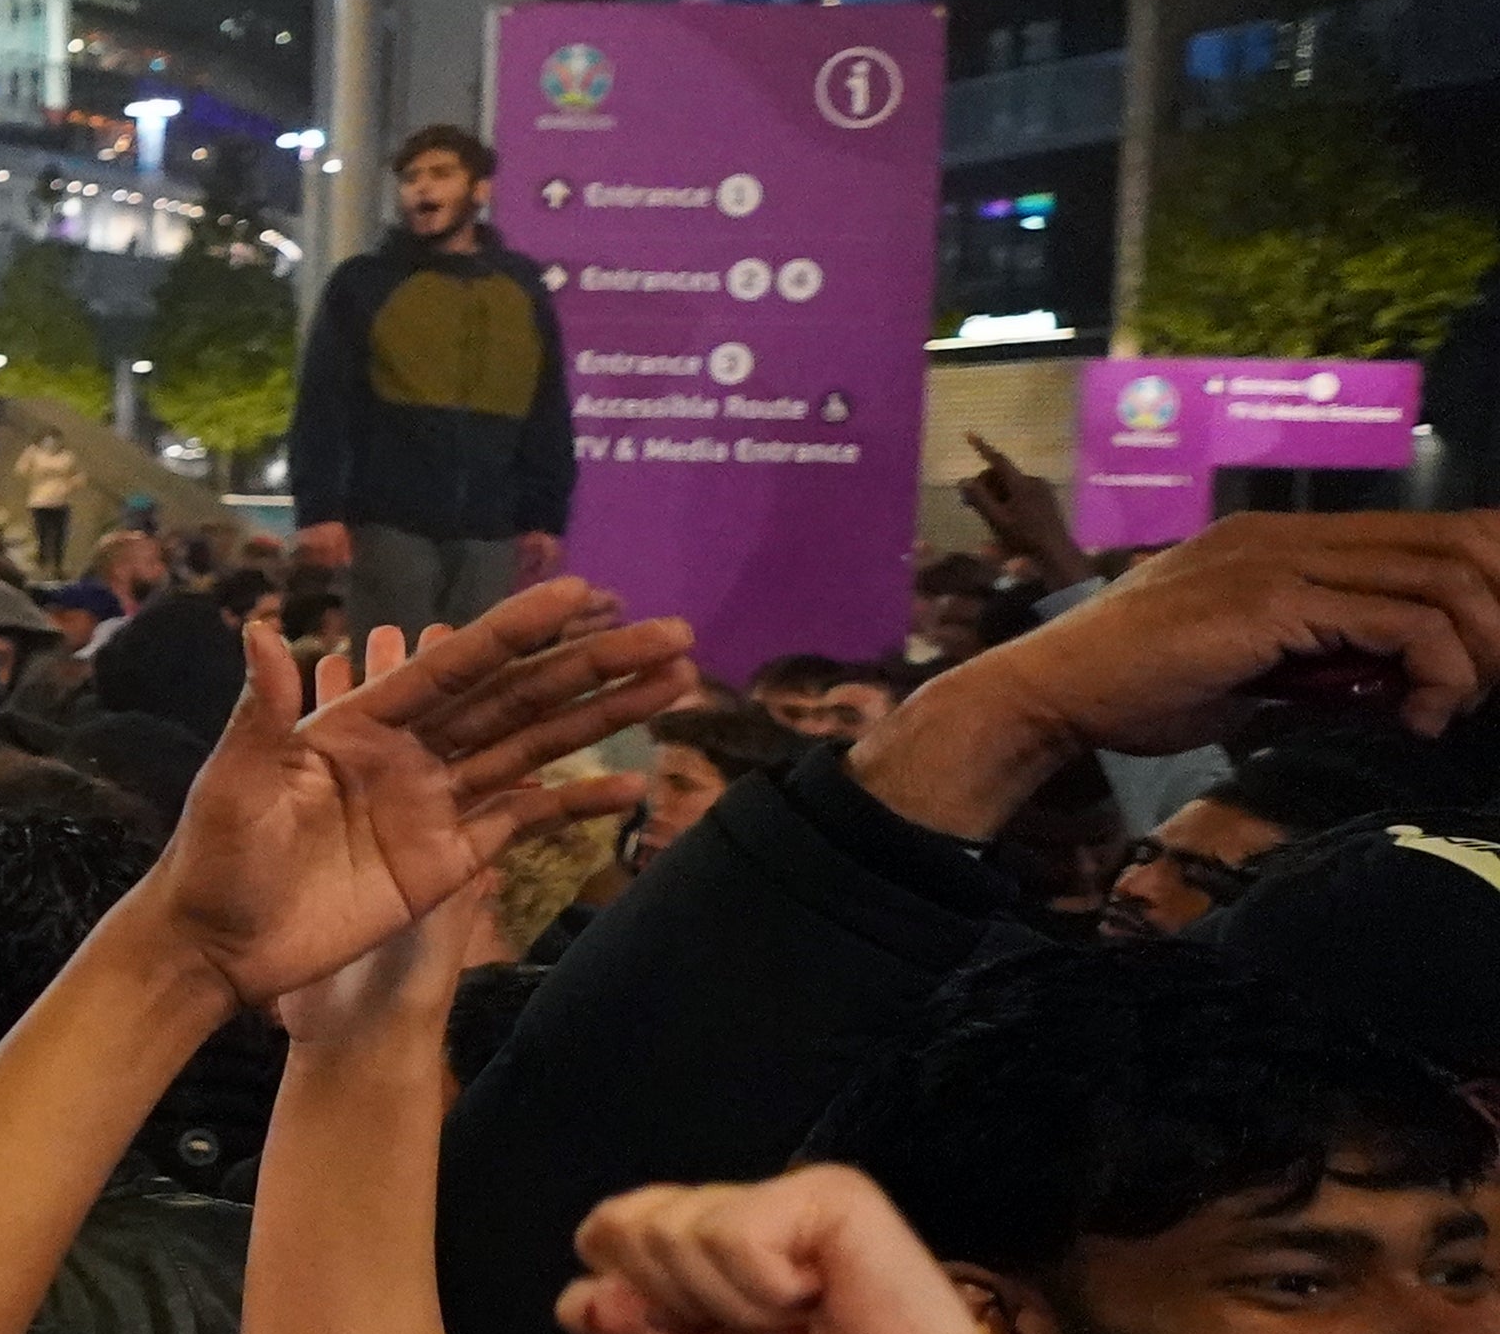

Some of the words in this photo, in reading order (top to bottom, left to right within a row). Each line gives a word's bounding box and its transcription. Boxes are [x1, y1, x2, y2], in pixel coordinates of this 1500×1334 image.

[583, 181, 713, 208] Entrance
[579, 265, 721, 292] Entrances
[575, 349, 703, 375] Entrance
[571, 392, 719, 419] Accessible
[723, 393, 809, 420] Route
[572, 435, 611, 460] TV
[612, 436, 636, 462] &
[642, 436, 729, 463] Media
[733, 437, 860, 464] Entrance
